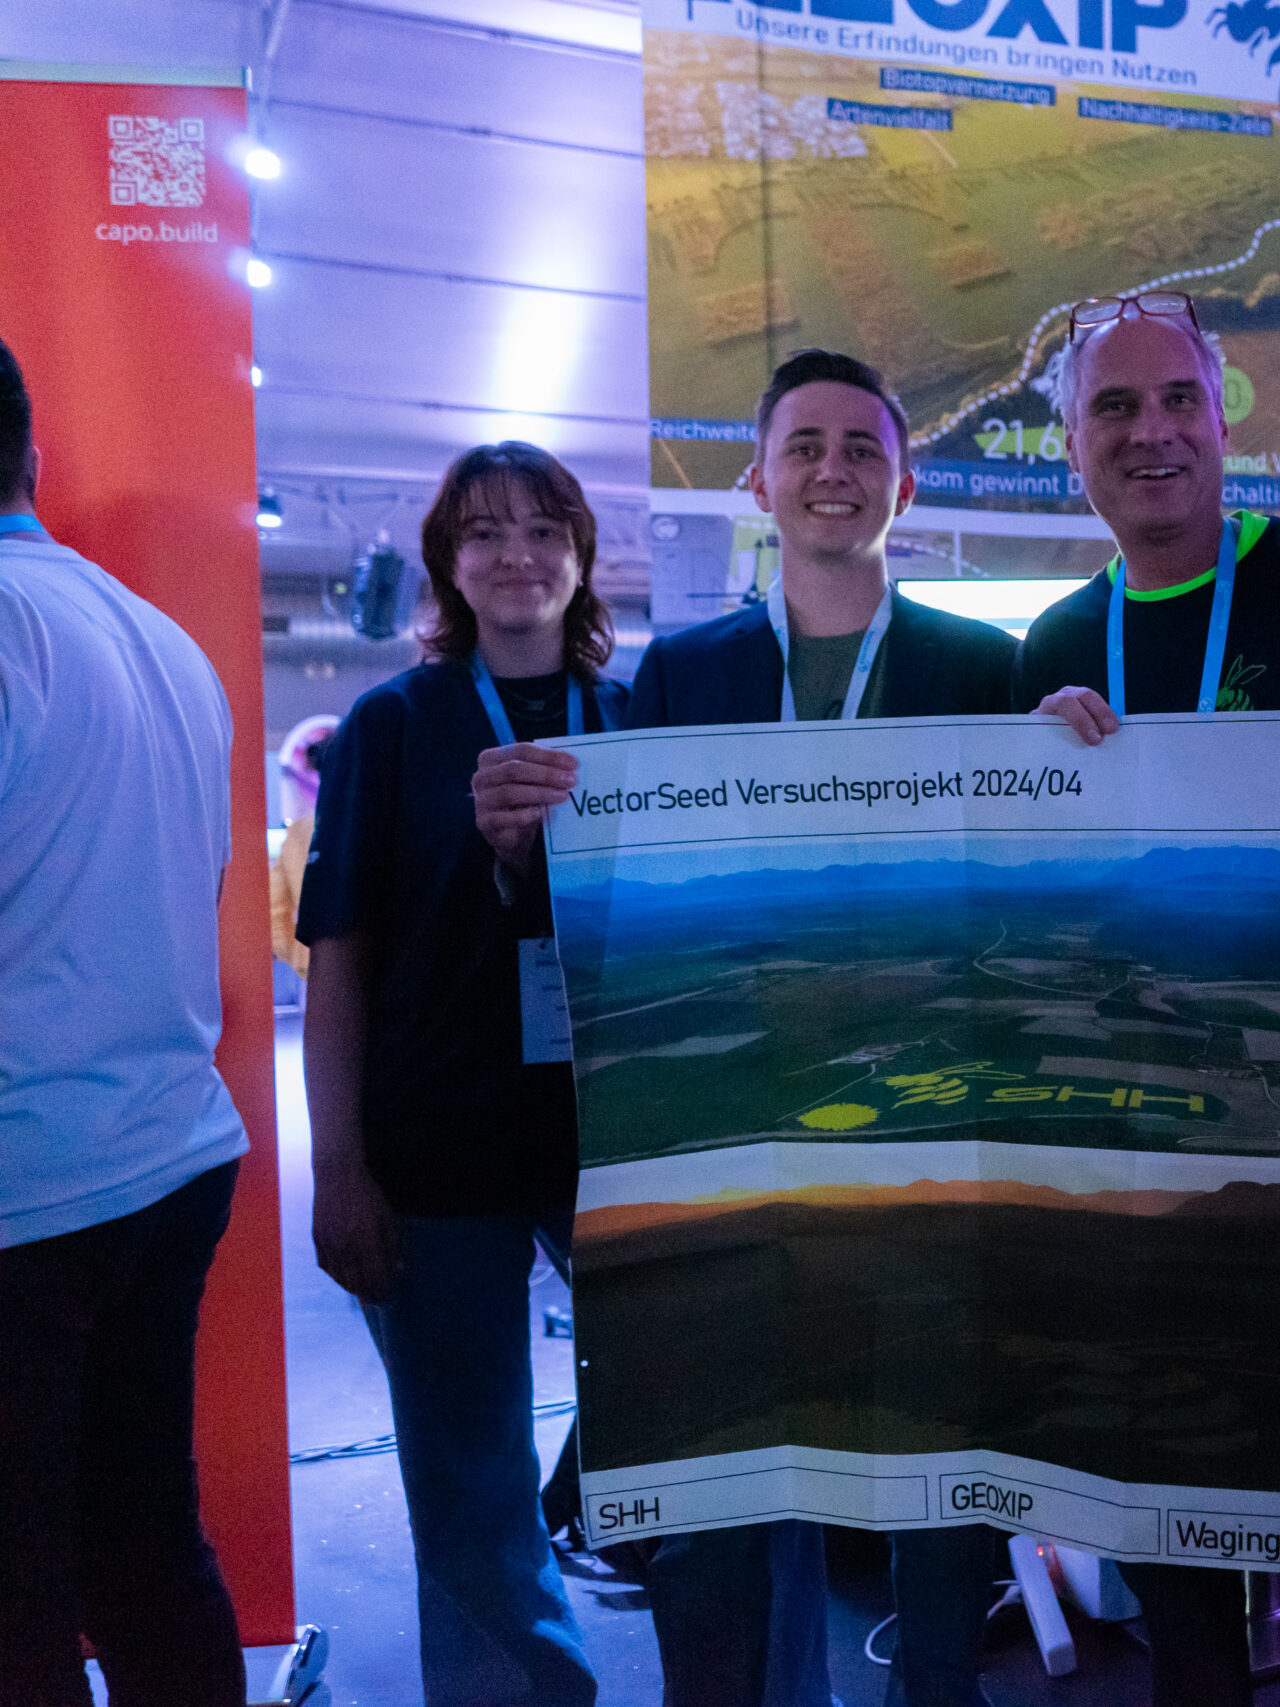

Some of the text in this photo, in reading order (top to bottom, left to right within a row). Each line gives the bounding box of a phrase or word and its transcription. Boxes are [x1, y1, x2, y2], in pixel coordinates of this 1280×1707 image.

[736, 9, 1198, 86] Unsere Erfindungen bringen Nutzen
[96, 221, 218, 246] capo.build
[982, 417, 1063, 466] 21,6
[969, 472, 1060, 496] gewinnt
[568, 765, 1083, 817] VectorSeed Versuchsprojekt 2024/04
[598, 1496, 661, 1530] SHH
[950, 1482, 1034, 1520] GEOXIP
